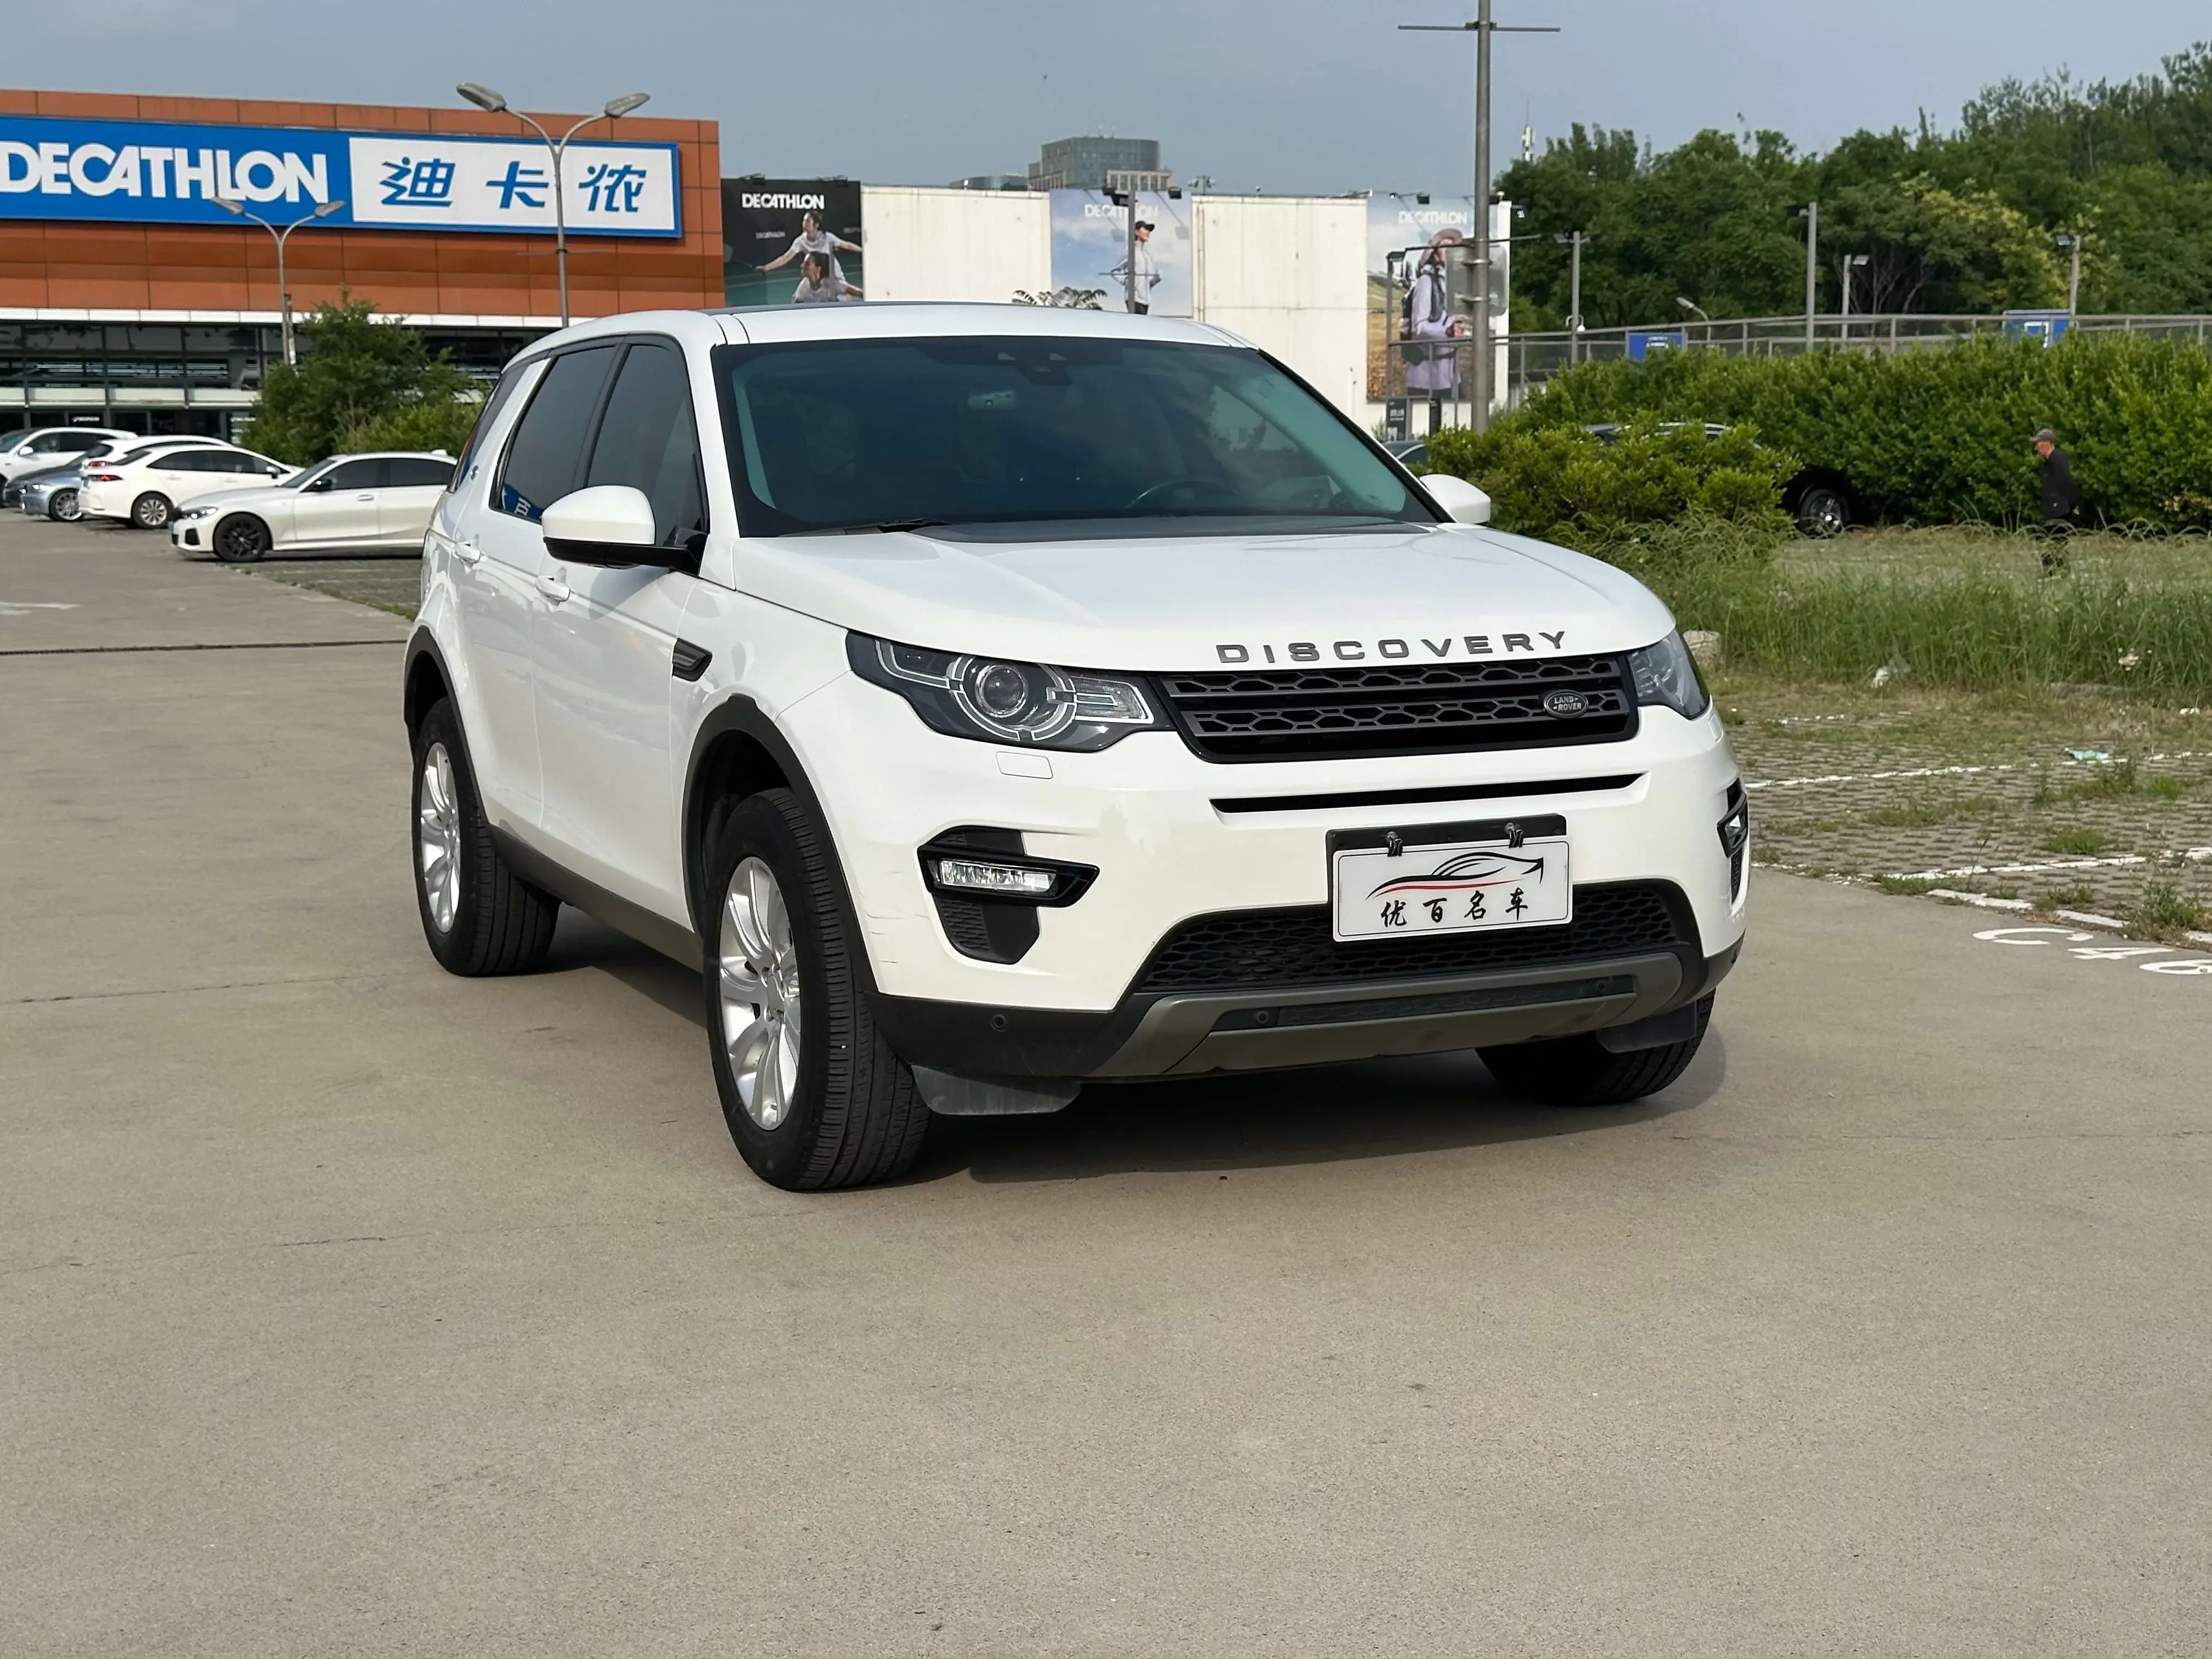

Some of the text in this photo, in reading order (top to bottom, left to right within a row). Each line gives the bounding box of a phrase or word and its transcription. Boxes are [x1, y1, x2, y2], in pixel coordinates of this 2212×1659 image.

[0, 140, 329, 204] DECATHLON
[379, 156, 646, 213] 迪卡侬
[742, 193, 825, 210] DECATHLON
[1216, 631, 1565, 663] DISCOVERY
[1554, 696, 1574, 704] LAND
[1558, 702, 1582, 712] ROVER
[1381, 887, 1528, 928] 优百名车
